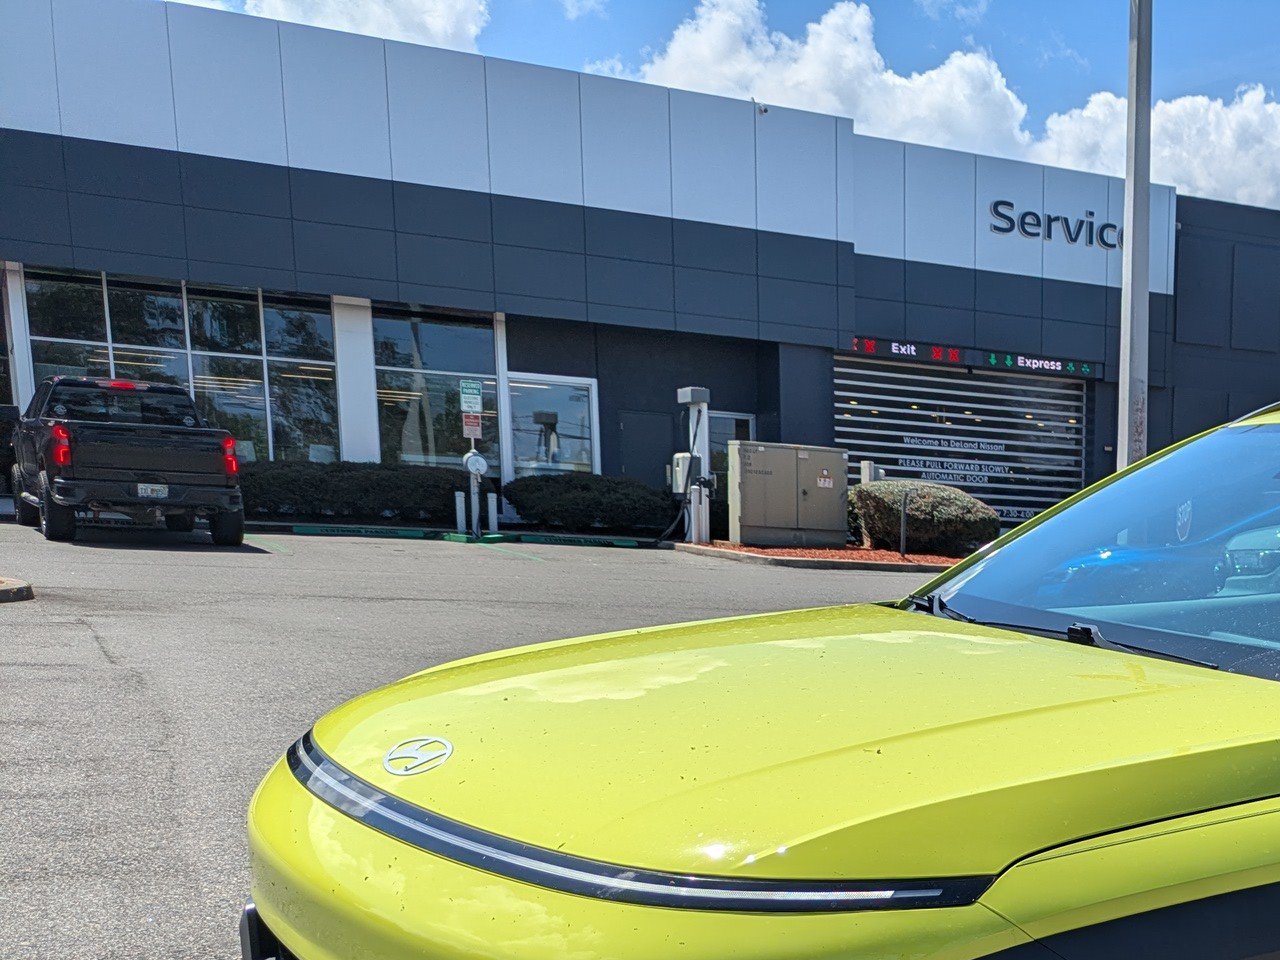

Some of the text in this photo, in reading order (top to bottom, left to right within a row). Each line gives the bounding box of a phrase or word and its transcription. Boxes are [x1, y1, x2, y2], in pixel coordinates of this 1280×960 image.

[990, 200, 1124, 250] Servic
[891, 342, 917, 356] Exit
[1017, 356, 1062, 371] Express
[903, 436, 939, 447] Welcome
[941, 439, 948, 447] to
[950, 440, 978, 449] DeLand
[898, 459, 1010, 473] PLEASE PULL FORWARD SLOWLY
[921, 472, 989, 484] AUTOMATIC DOOR
